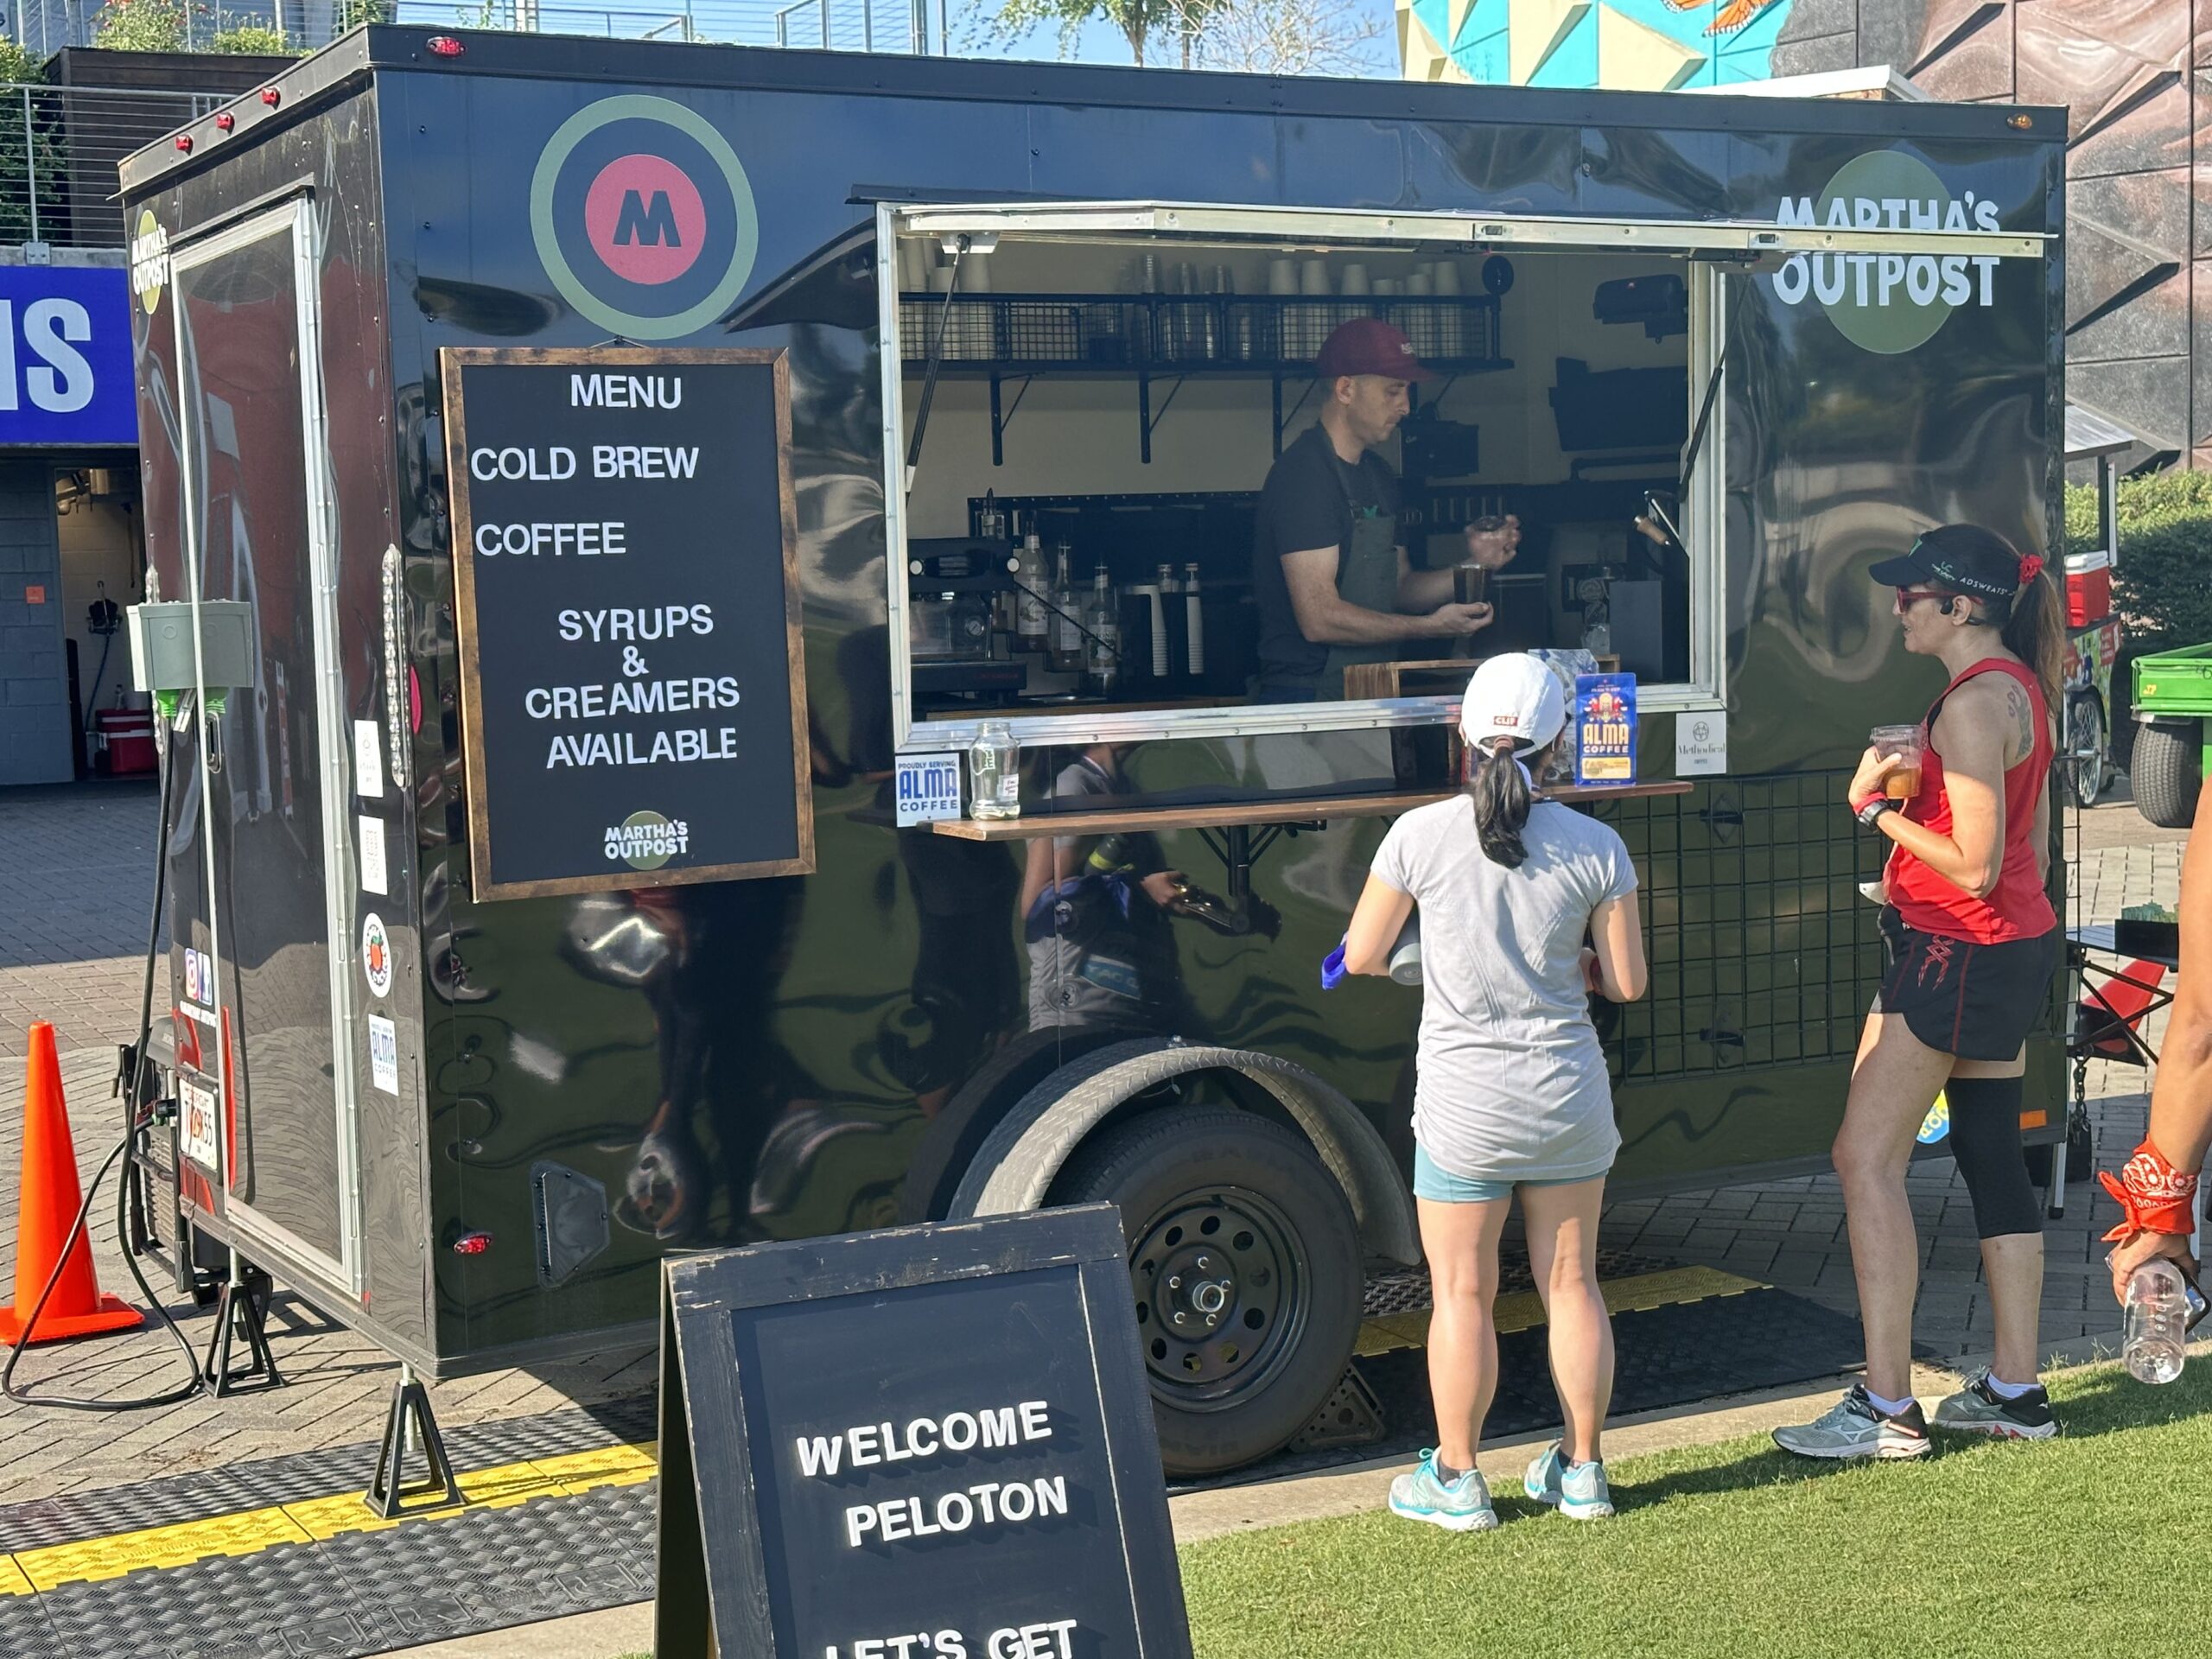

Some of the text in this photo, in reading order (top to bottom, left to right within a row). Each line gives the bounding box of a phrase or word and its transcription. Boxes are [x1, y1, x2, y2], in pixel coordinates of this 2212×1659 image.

[613, 189, 682, 248] M
[1772, 252, 2000, 306] OUTPOST
[571, 374, 682, 410] MENU
[471, 446, 699, 481] COLD BREW
[475, 522, 626, 556] COFFEE
[558, 604, 714, 642] SYRUPS
[622, 646, 649, 677] &
[525, 677, 741, 720] CREAMERS
[1495, 716, 1516, 726] CLIF
[1583, 723, 1630, 745] ALMA
[546, 728, 737, 769] AVAILABLE
[929, 760, 957, 769] SERVING
[899, 768, 957, 799] ALMA
[900, 799, 957, 812] COFFEE
[604, 819, 689, 842] MARTHA'S
[605, 836, 689, 859] OUTPOST
[798, 1401, 1052, 1477] WELCOME
[846, 1476, 1068, 1547] PELOTON
[988, 1619, 1077, 1659] GET
